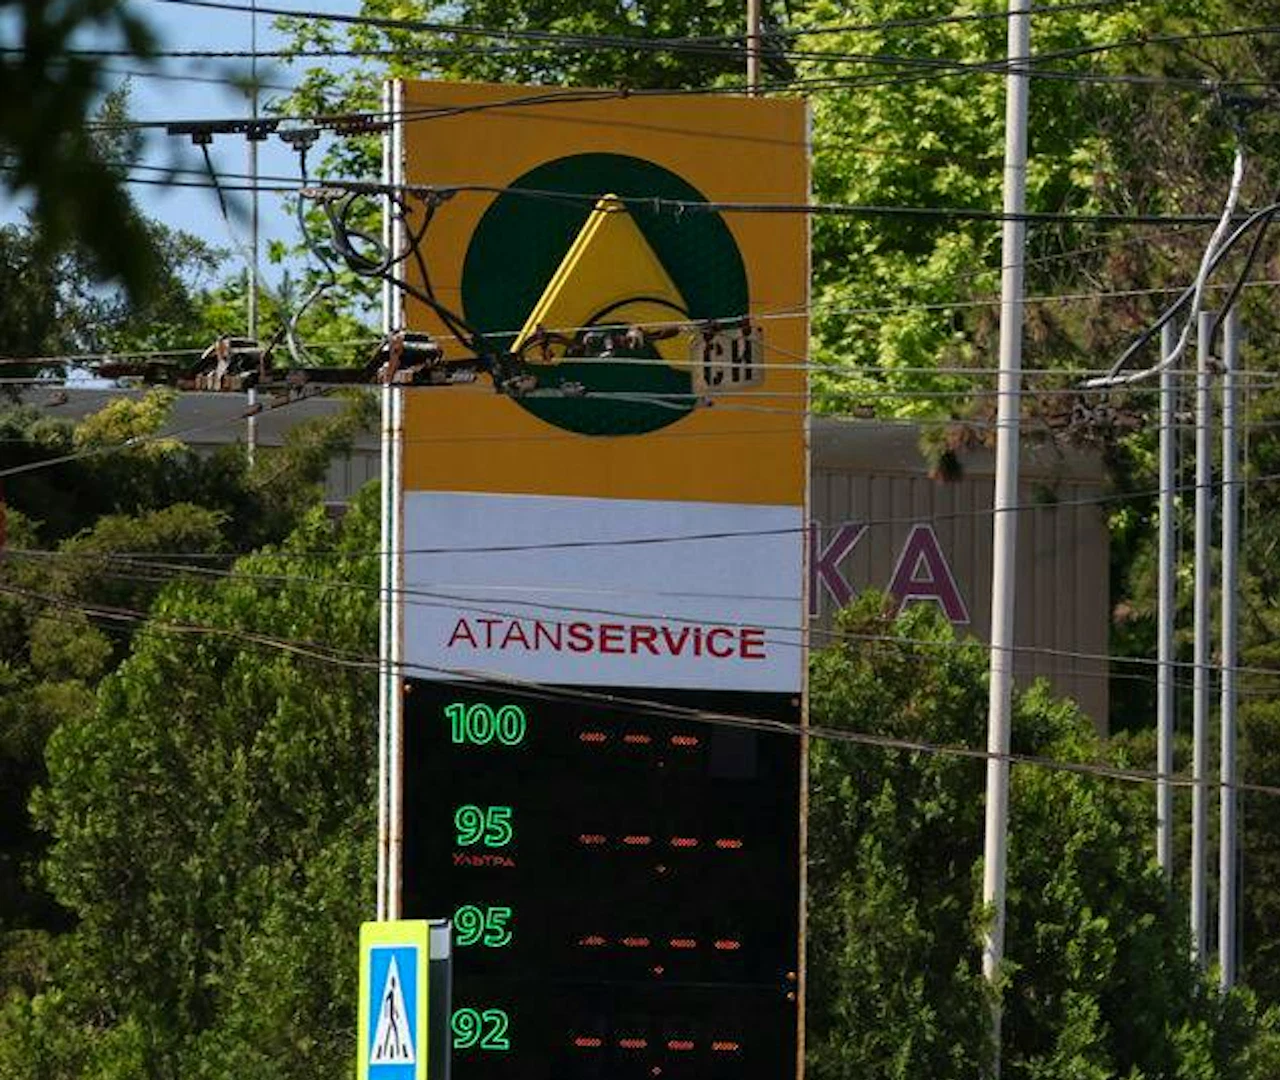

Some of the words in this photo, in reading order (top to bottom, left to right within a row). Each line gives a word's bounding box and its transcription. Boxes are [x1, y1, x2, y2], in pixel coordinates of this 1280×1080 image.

[444, 703, 527, 745] 100
[453, 804, 513, 848] 95
[453, 904, 513, 947] 95
[450, 1008, 510, 1050] 92
